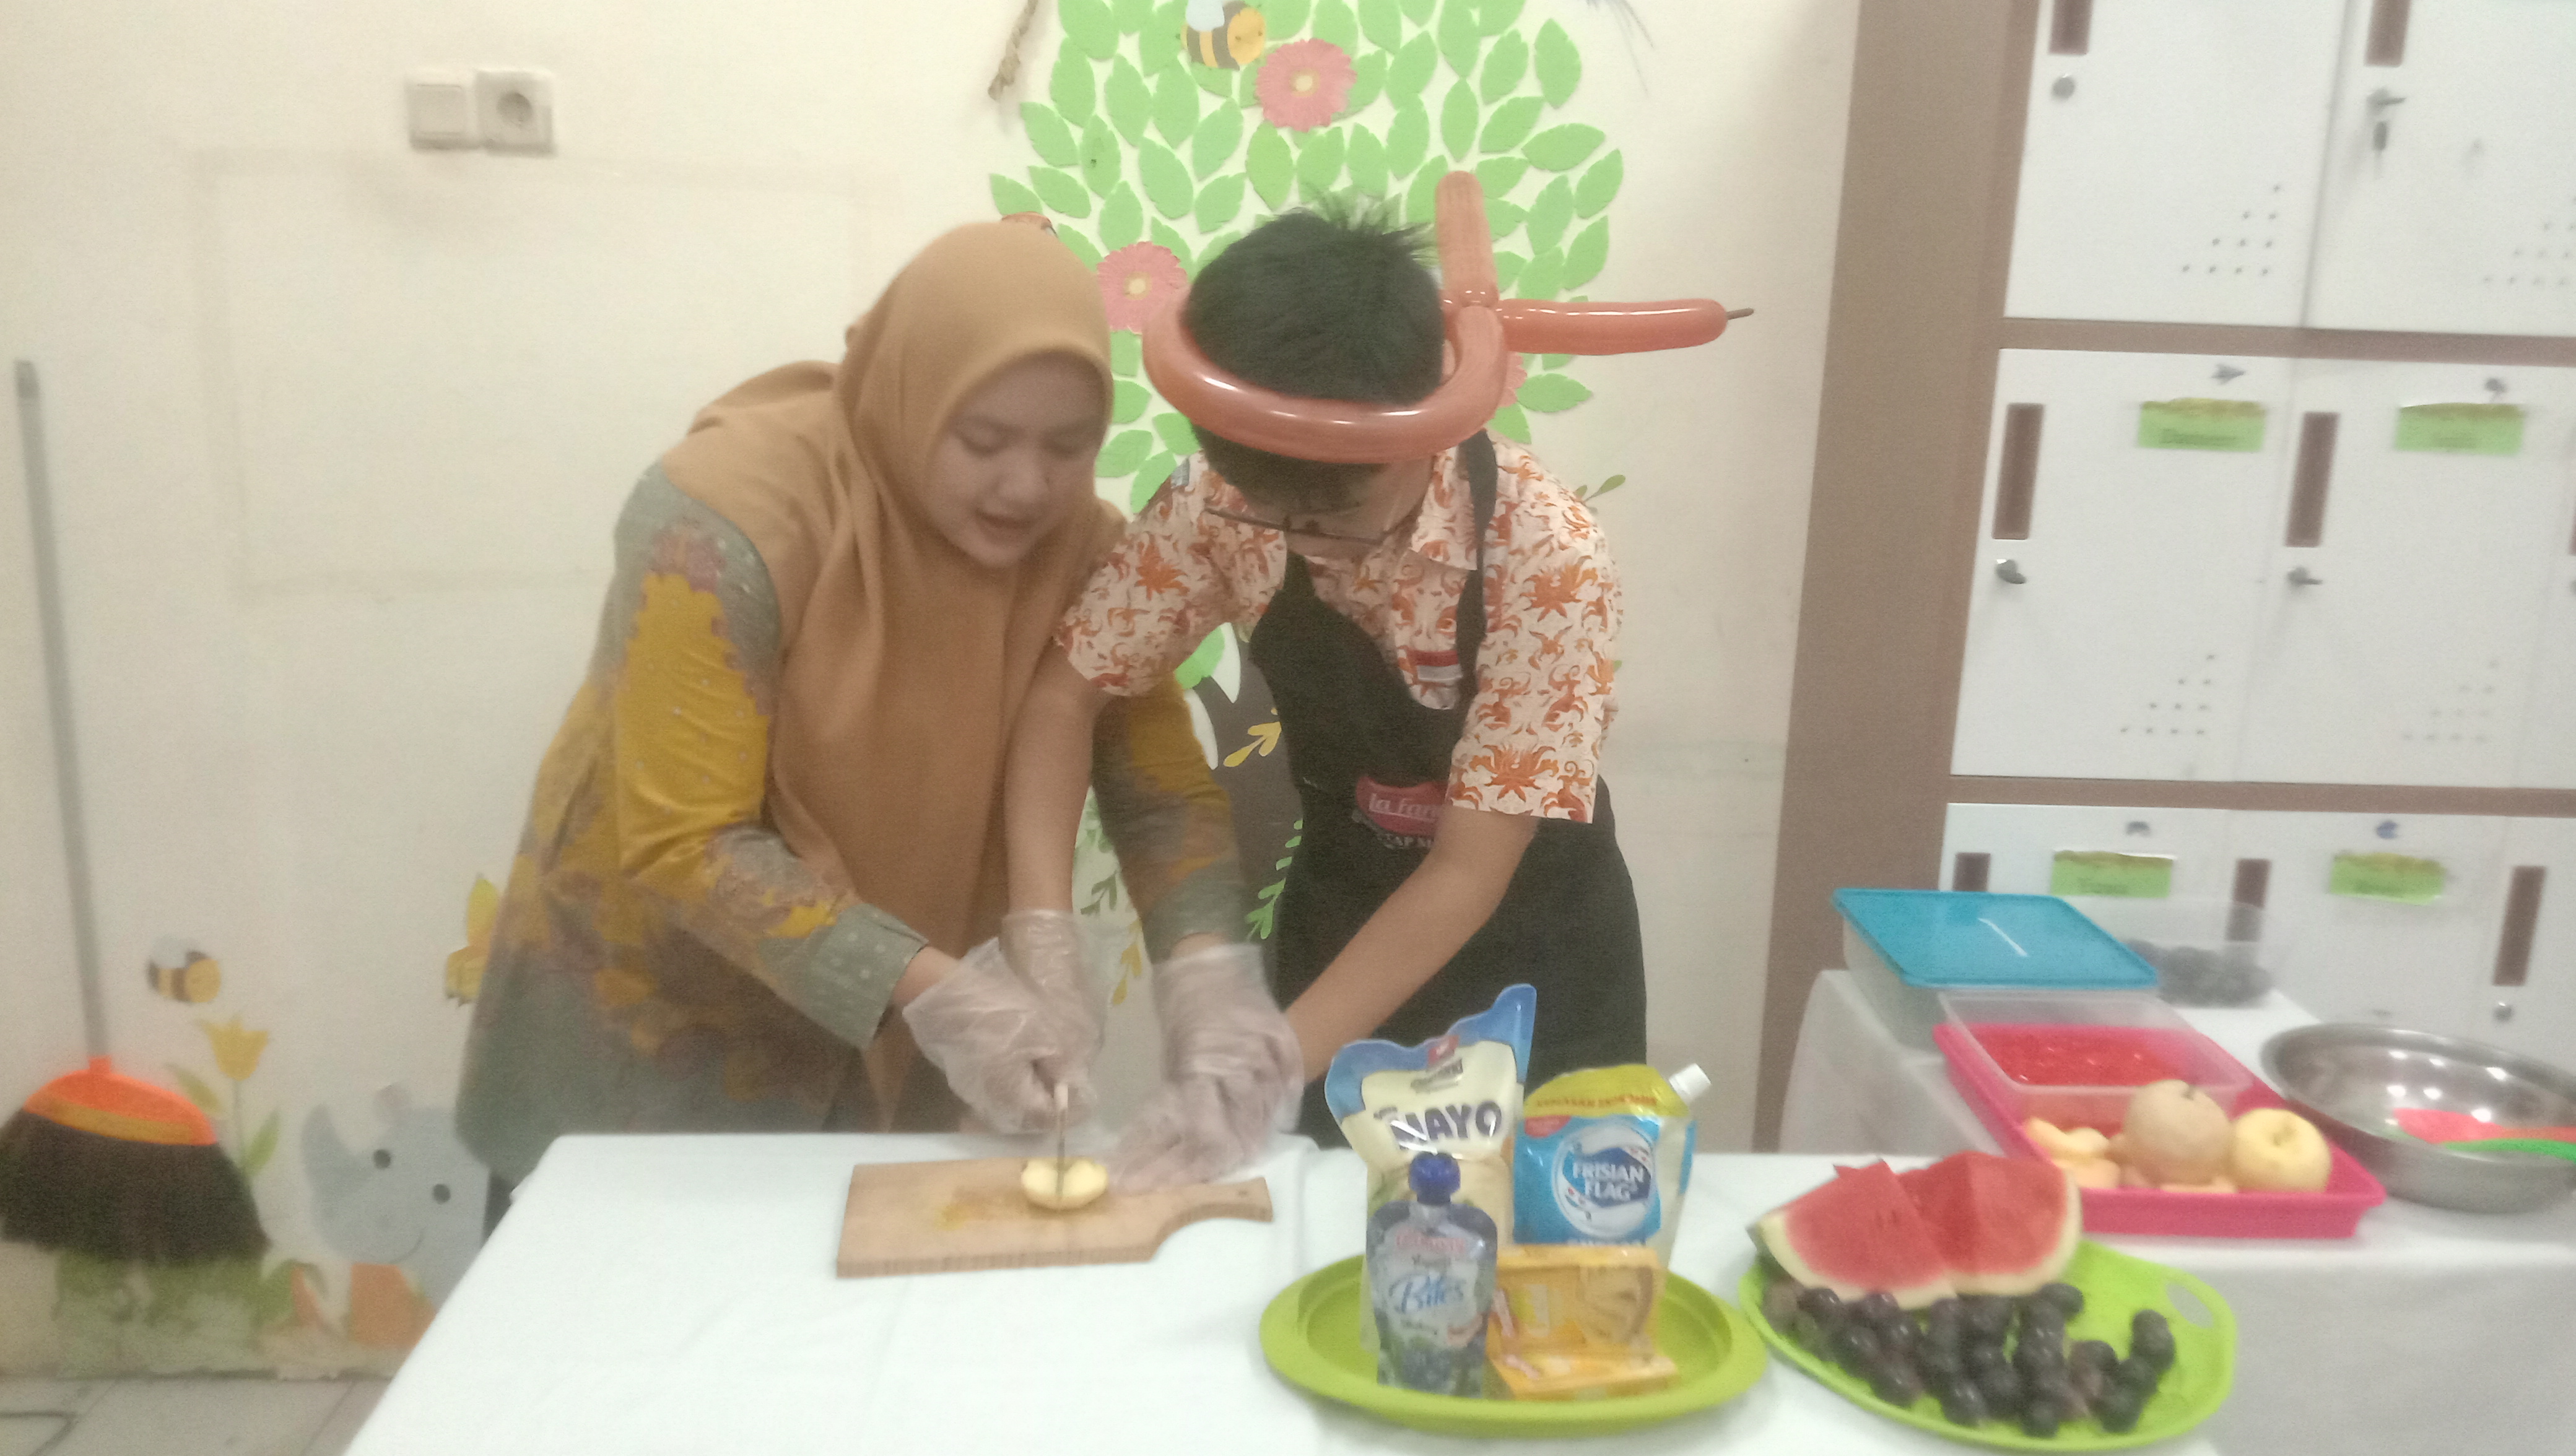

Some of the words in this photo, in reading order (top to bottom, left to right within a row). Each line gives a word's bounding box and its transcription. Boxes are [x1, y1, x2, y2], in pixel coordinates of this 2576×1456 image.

[1369, 793, 1391, 813] la
[1572, 1162, 1645, 1183] FRISIAN
[1585, 1180, 1634, 1202] FLAG
